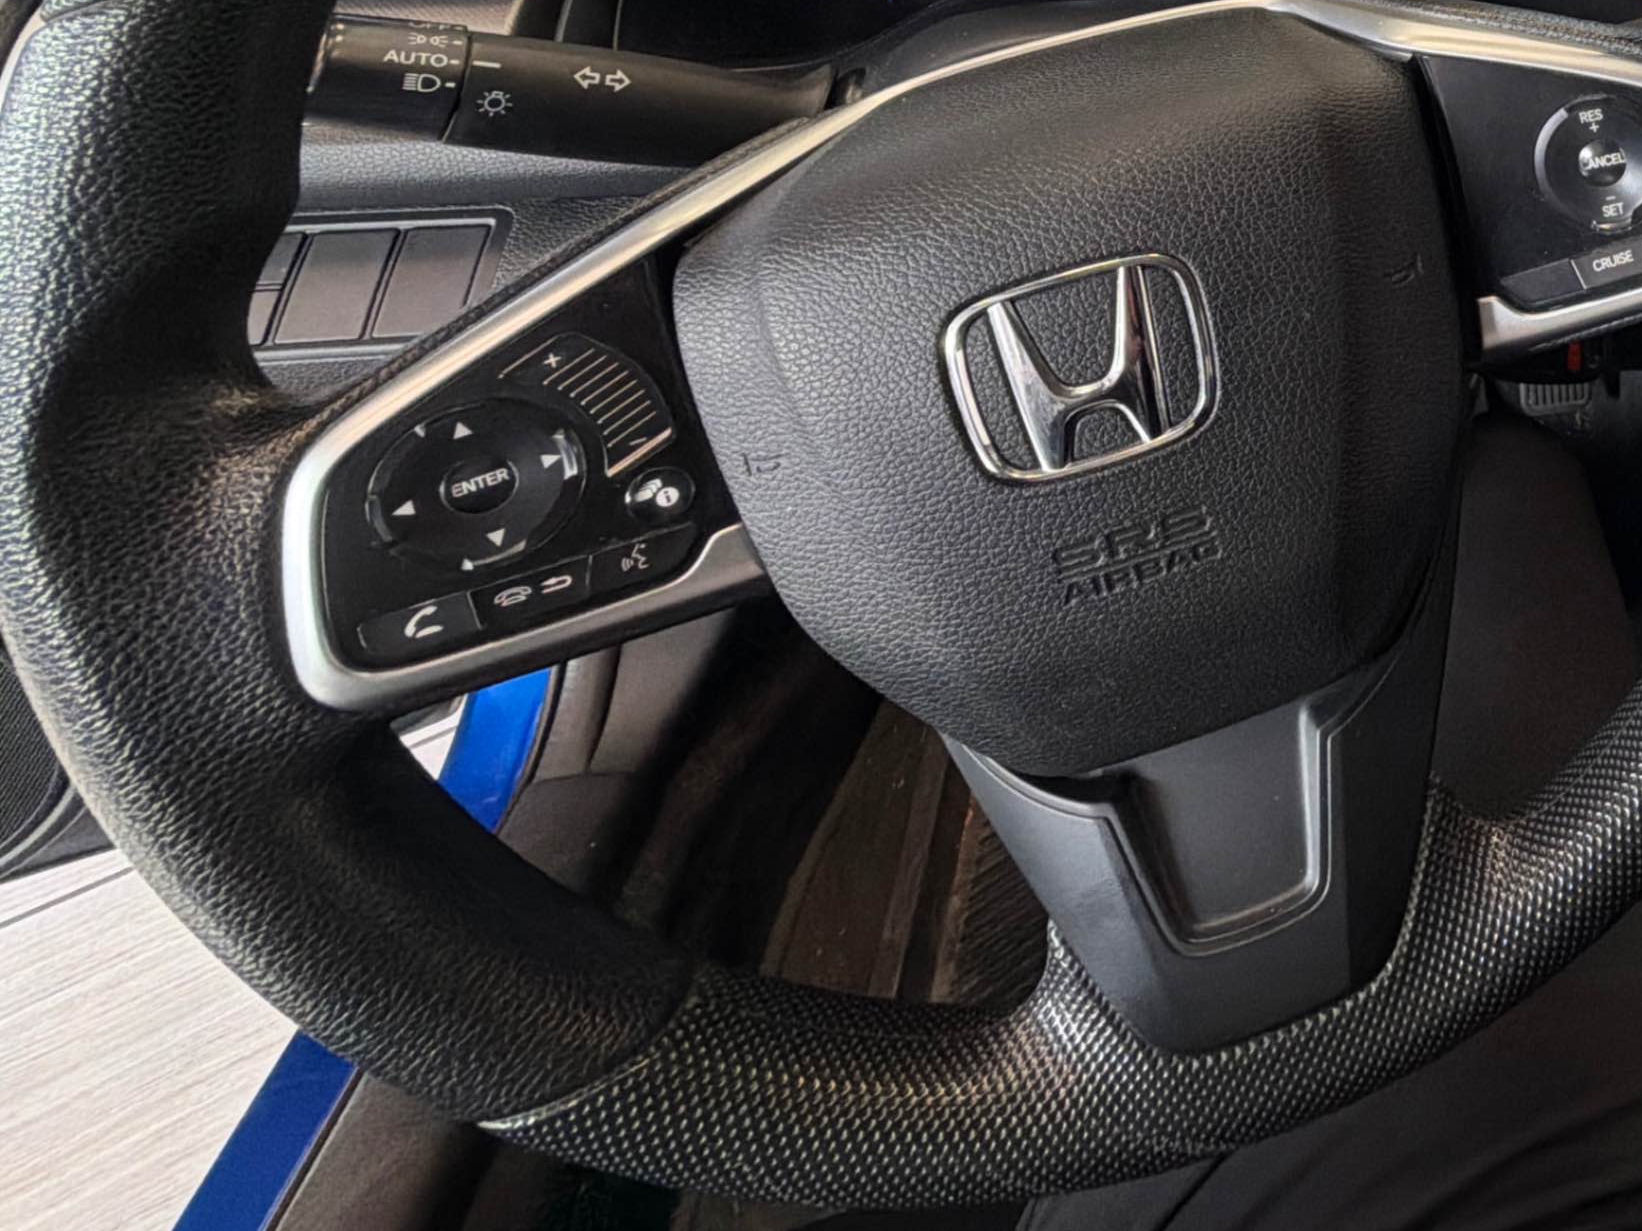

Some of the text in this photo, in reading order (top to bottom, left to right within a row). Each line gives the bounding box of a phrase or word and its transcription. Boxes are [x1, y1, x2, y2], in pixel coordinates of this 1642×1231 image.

[383, 49, 449, 68] AUTO
[1578, 108, 1604, 124] RES
[1601, 201, 1625, 218] SET
[1591, 249, 1635, 272] CRUISE
[451, 467, 511, 498] ENTER
